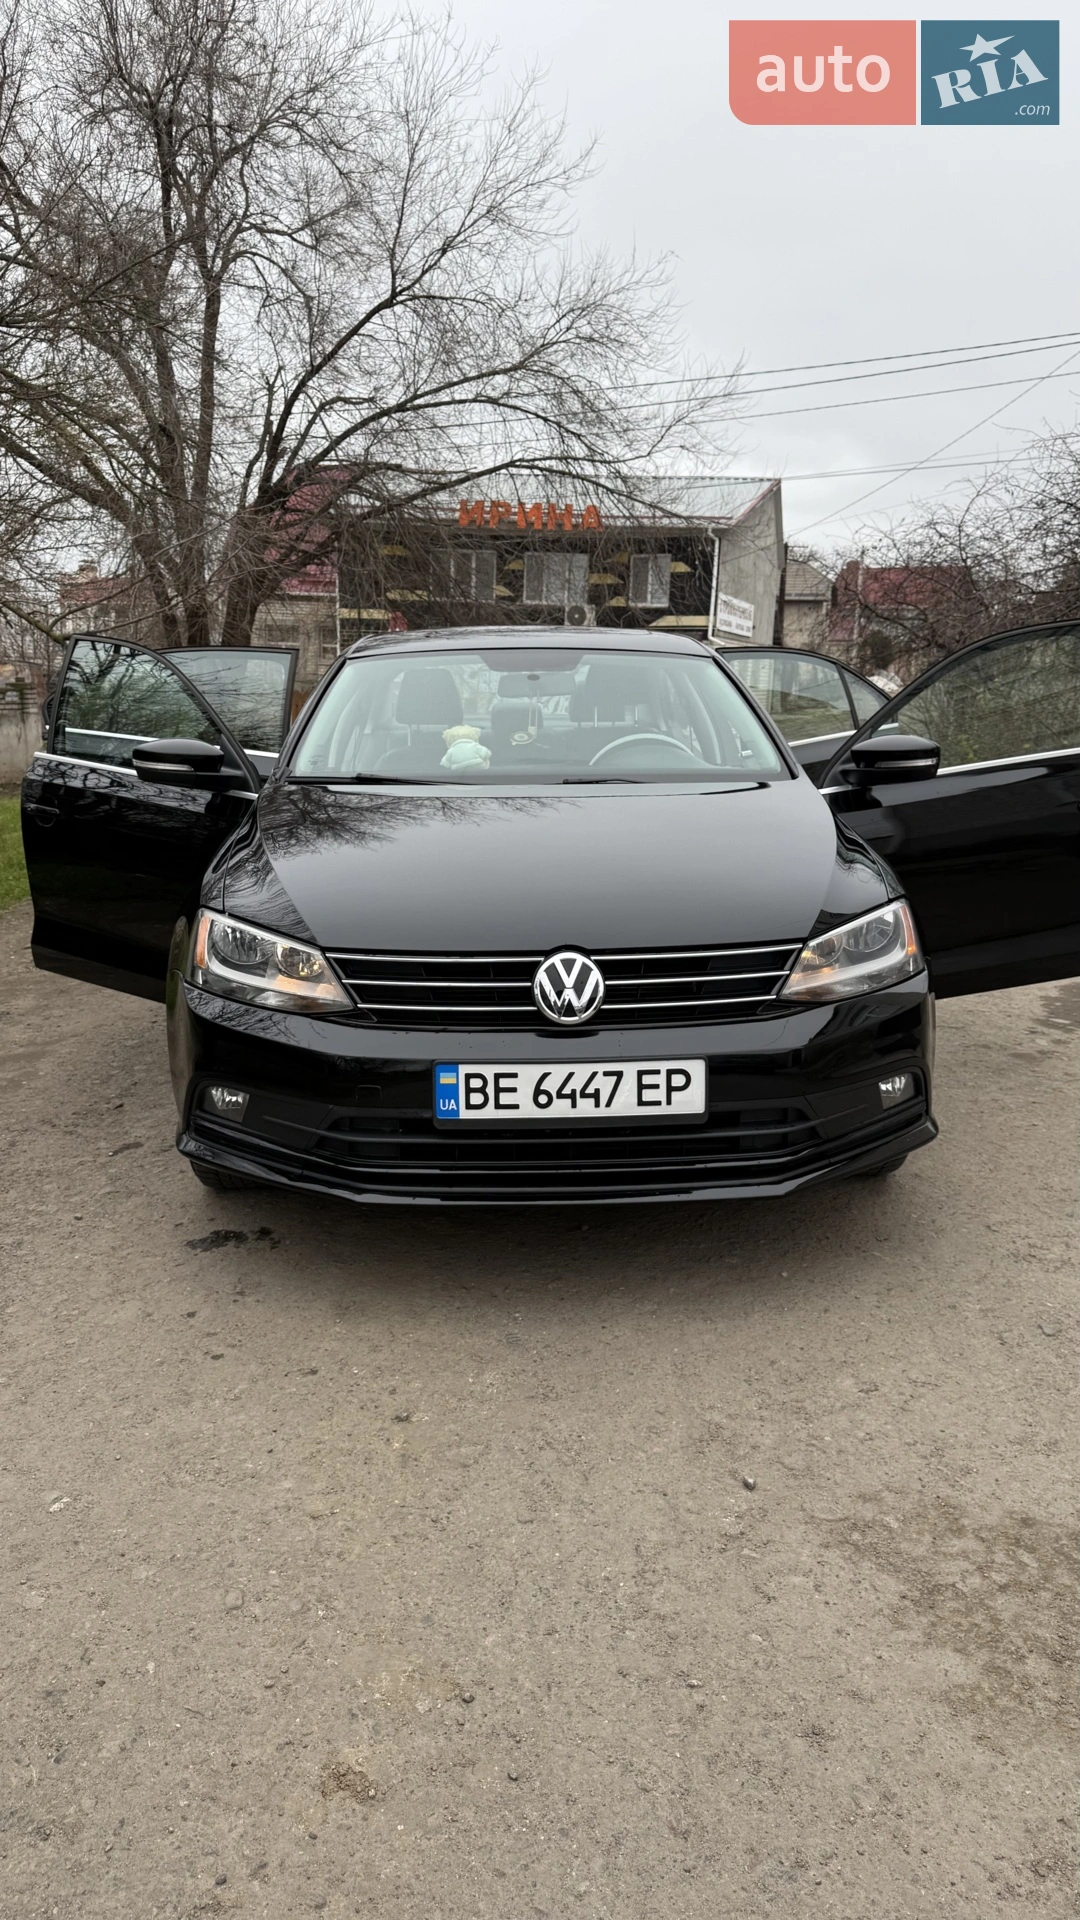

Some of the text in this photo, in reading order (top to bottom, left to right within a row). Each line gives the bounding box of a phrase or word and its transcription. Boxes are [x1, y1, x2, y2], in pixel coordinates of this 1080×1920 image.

[458, 500, 604, 531] ИРИНА
[464, 1068, 692, 1110] BE 6447 EP
[439, 1099, 458, 1111] UA
